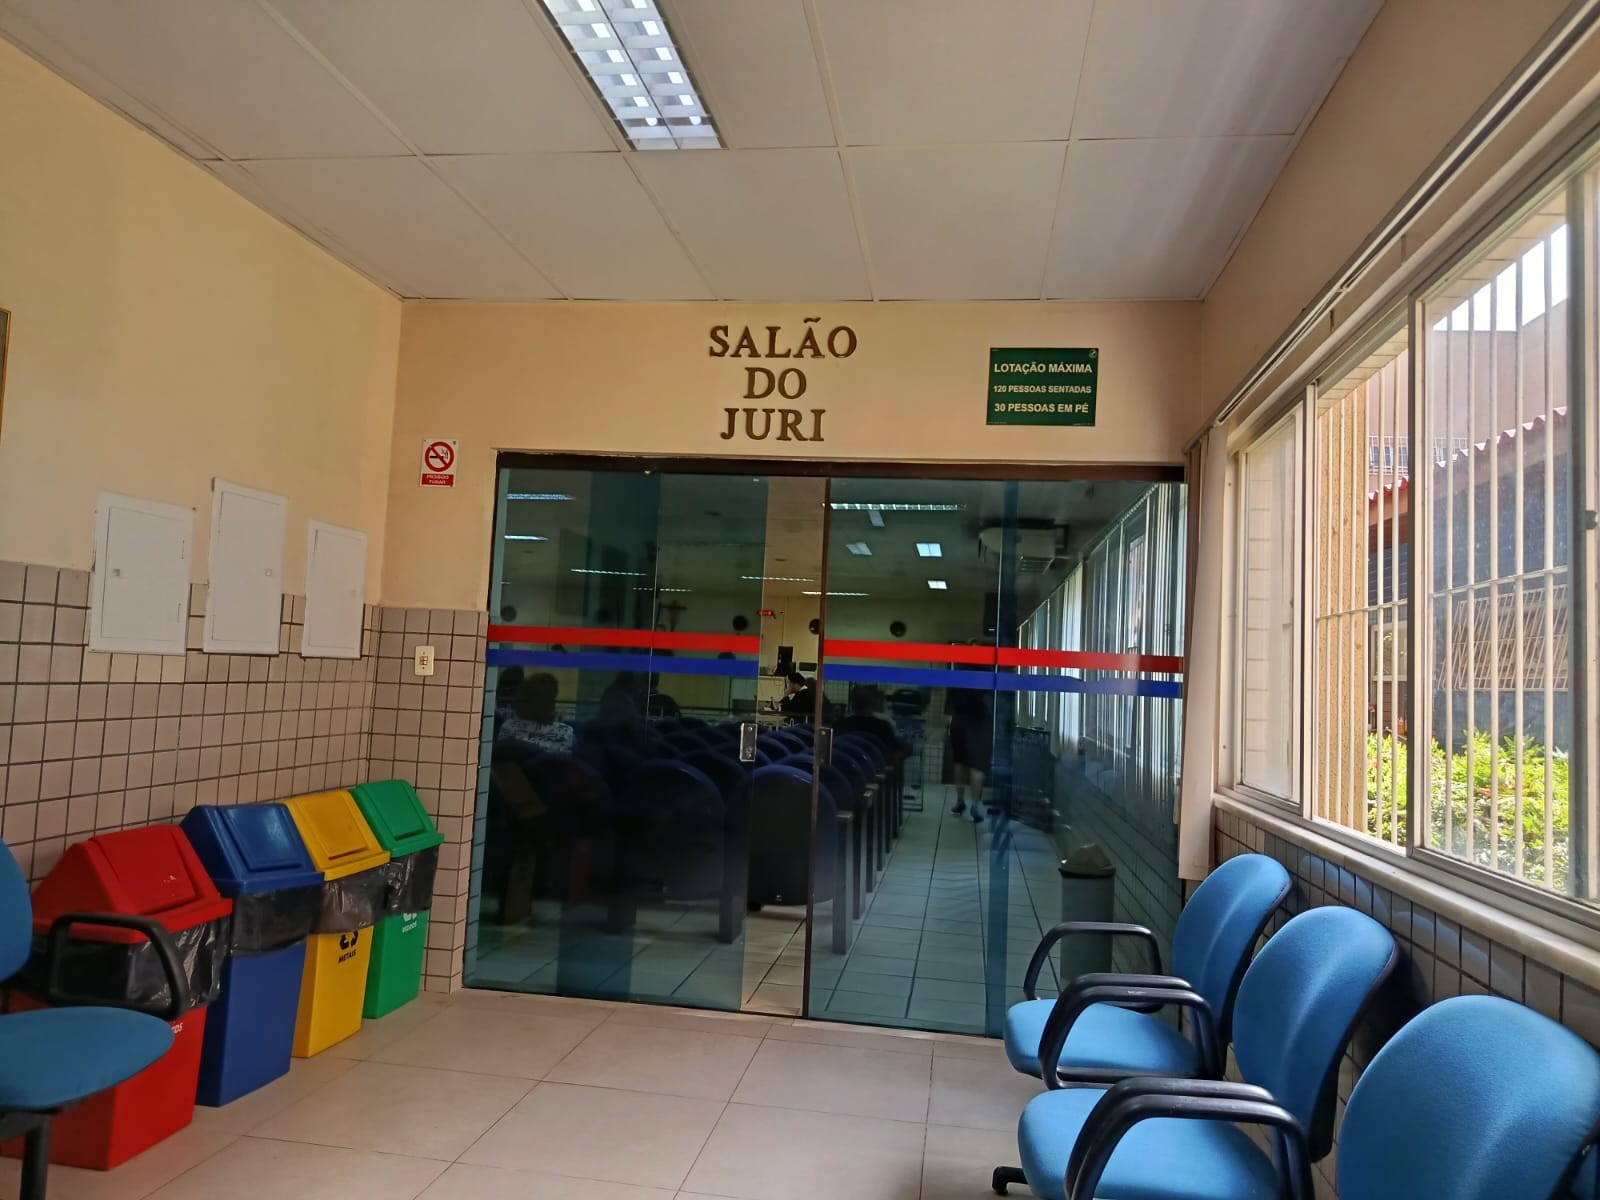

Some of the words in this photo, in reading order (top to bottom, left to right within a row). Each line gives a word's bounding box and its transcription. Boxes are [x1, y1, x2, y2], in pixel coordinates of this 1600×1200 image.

[709, 317, 857, 358] SALÃO
[994, 361, 1046, 374] LOTAÇÃO
[1048, 362, 1092, 373] MÁXIMA
[743, 367, 807, 399] DO
[1008, 385, 1046, 393] PESSOAS
[1048, 386, 1092, 394] SENTADAS
[994, 403, 1006, 412] 30
[1008, 403, 1055, 412] PESSOAS
[1057, 404, 1073, 412] EM
[1075, 402, 1089, 413] PÉ
[720, 408, 826, 442] JURI
